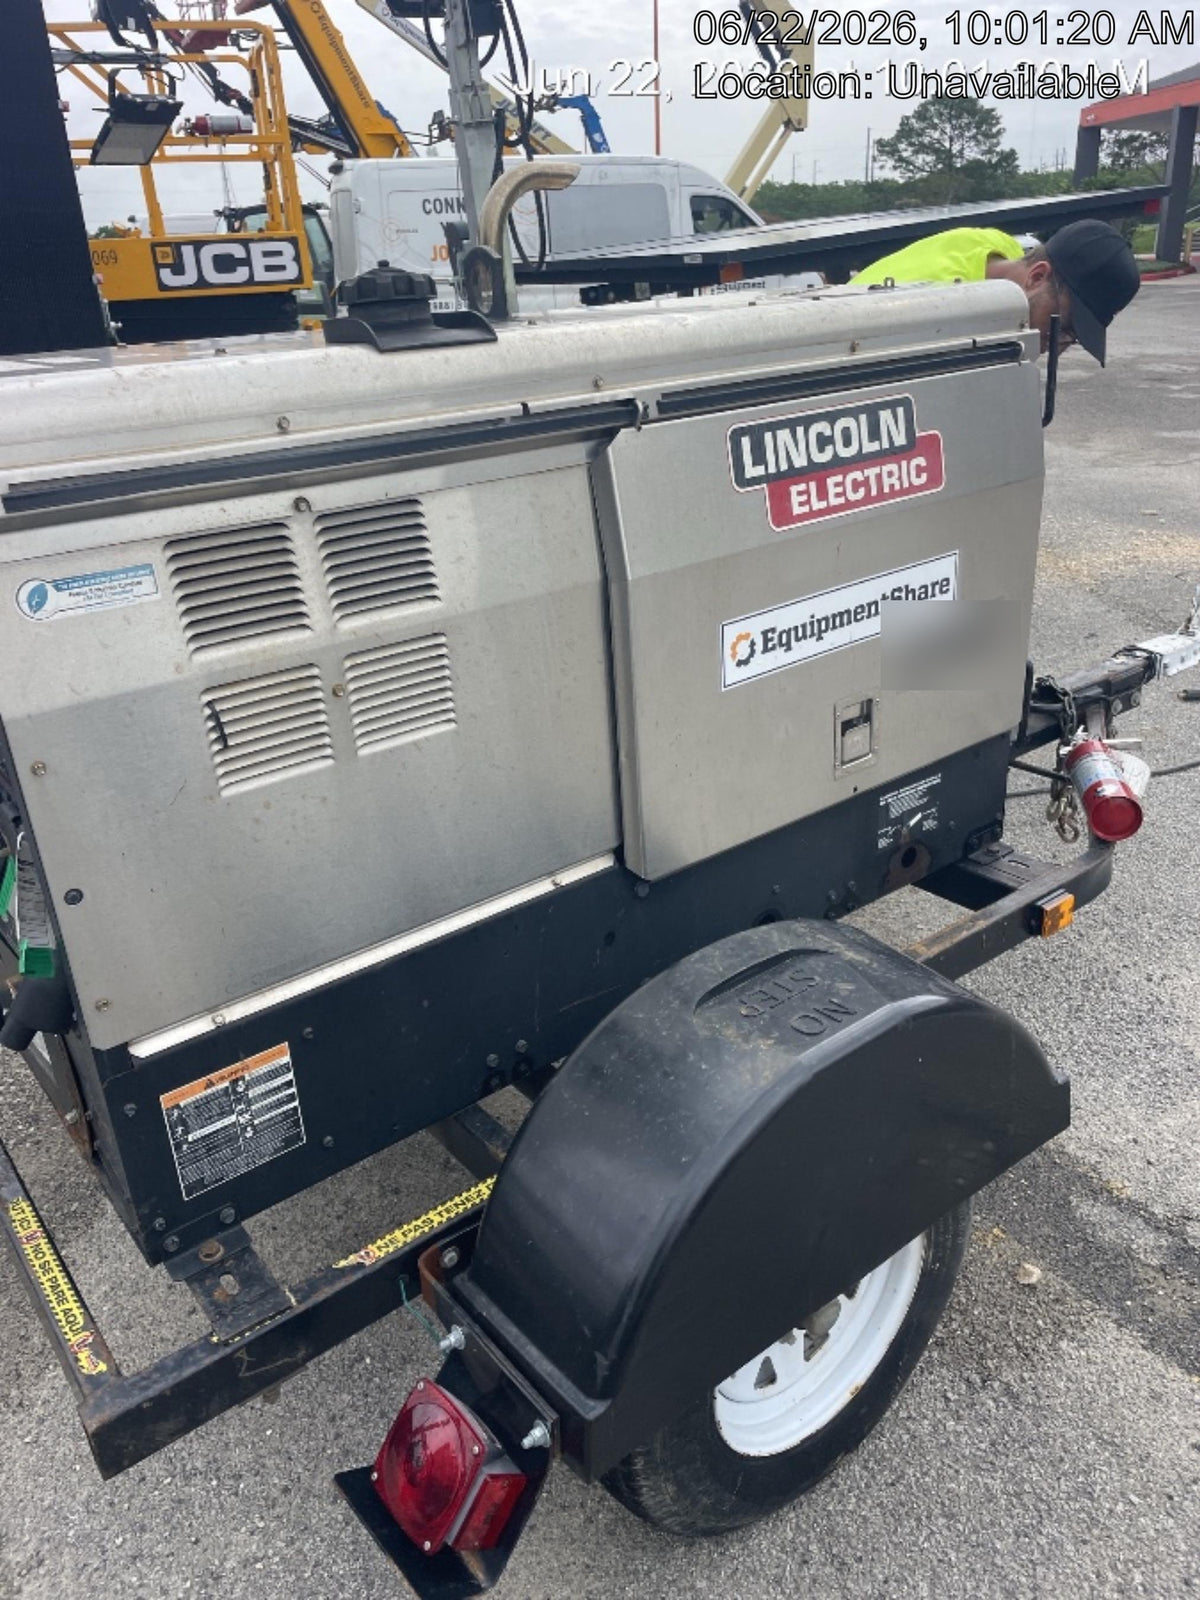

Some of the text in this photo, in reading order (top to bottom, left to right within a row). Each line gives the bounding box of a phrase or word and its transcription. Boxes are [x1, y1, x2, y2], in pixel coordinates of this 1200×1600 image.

[422, 197, 467, 215] CONN
[159, 241, 299, 287] JCB
[430, 244, 450, 262] JO
[741, 407, 907, 479] LINCOLN
[789, 456, 927, 516] ELECTRIC
[790, 997, 858, 1036] NO
[31, 1243, 46, 1261] NO
[38, 1259, 54, 1277] SE
[49, 1274, 70, 1306] PARE
[61, 1305, 83, 1338] AQUI
